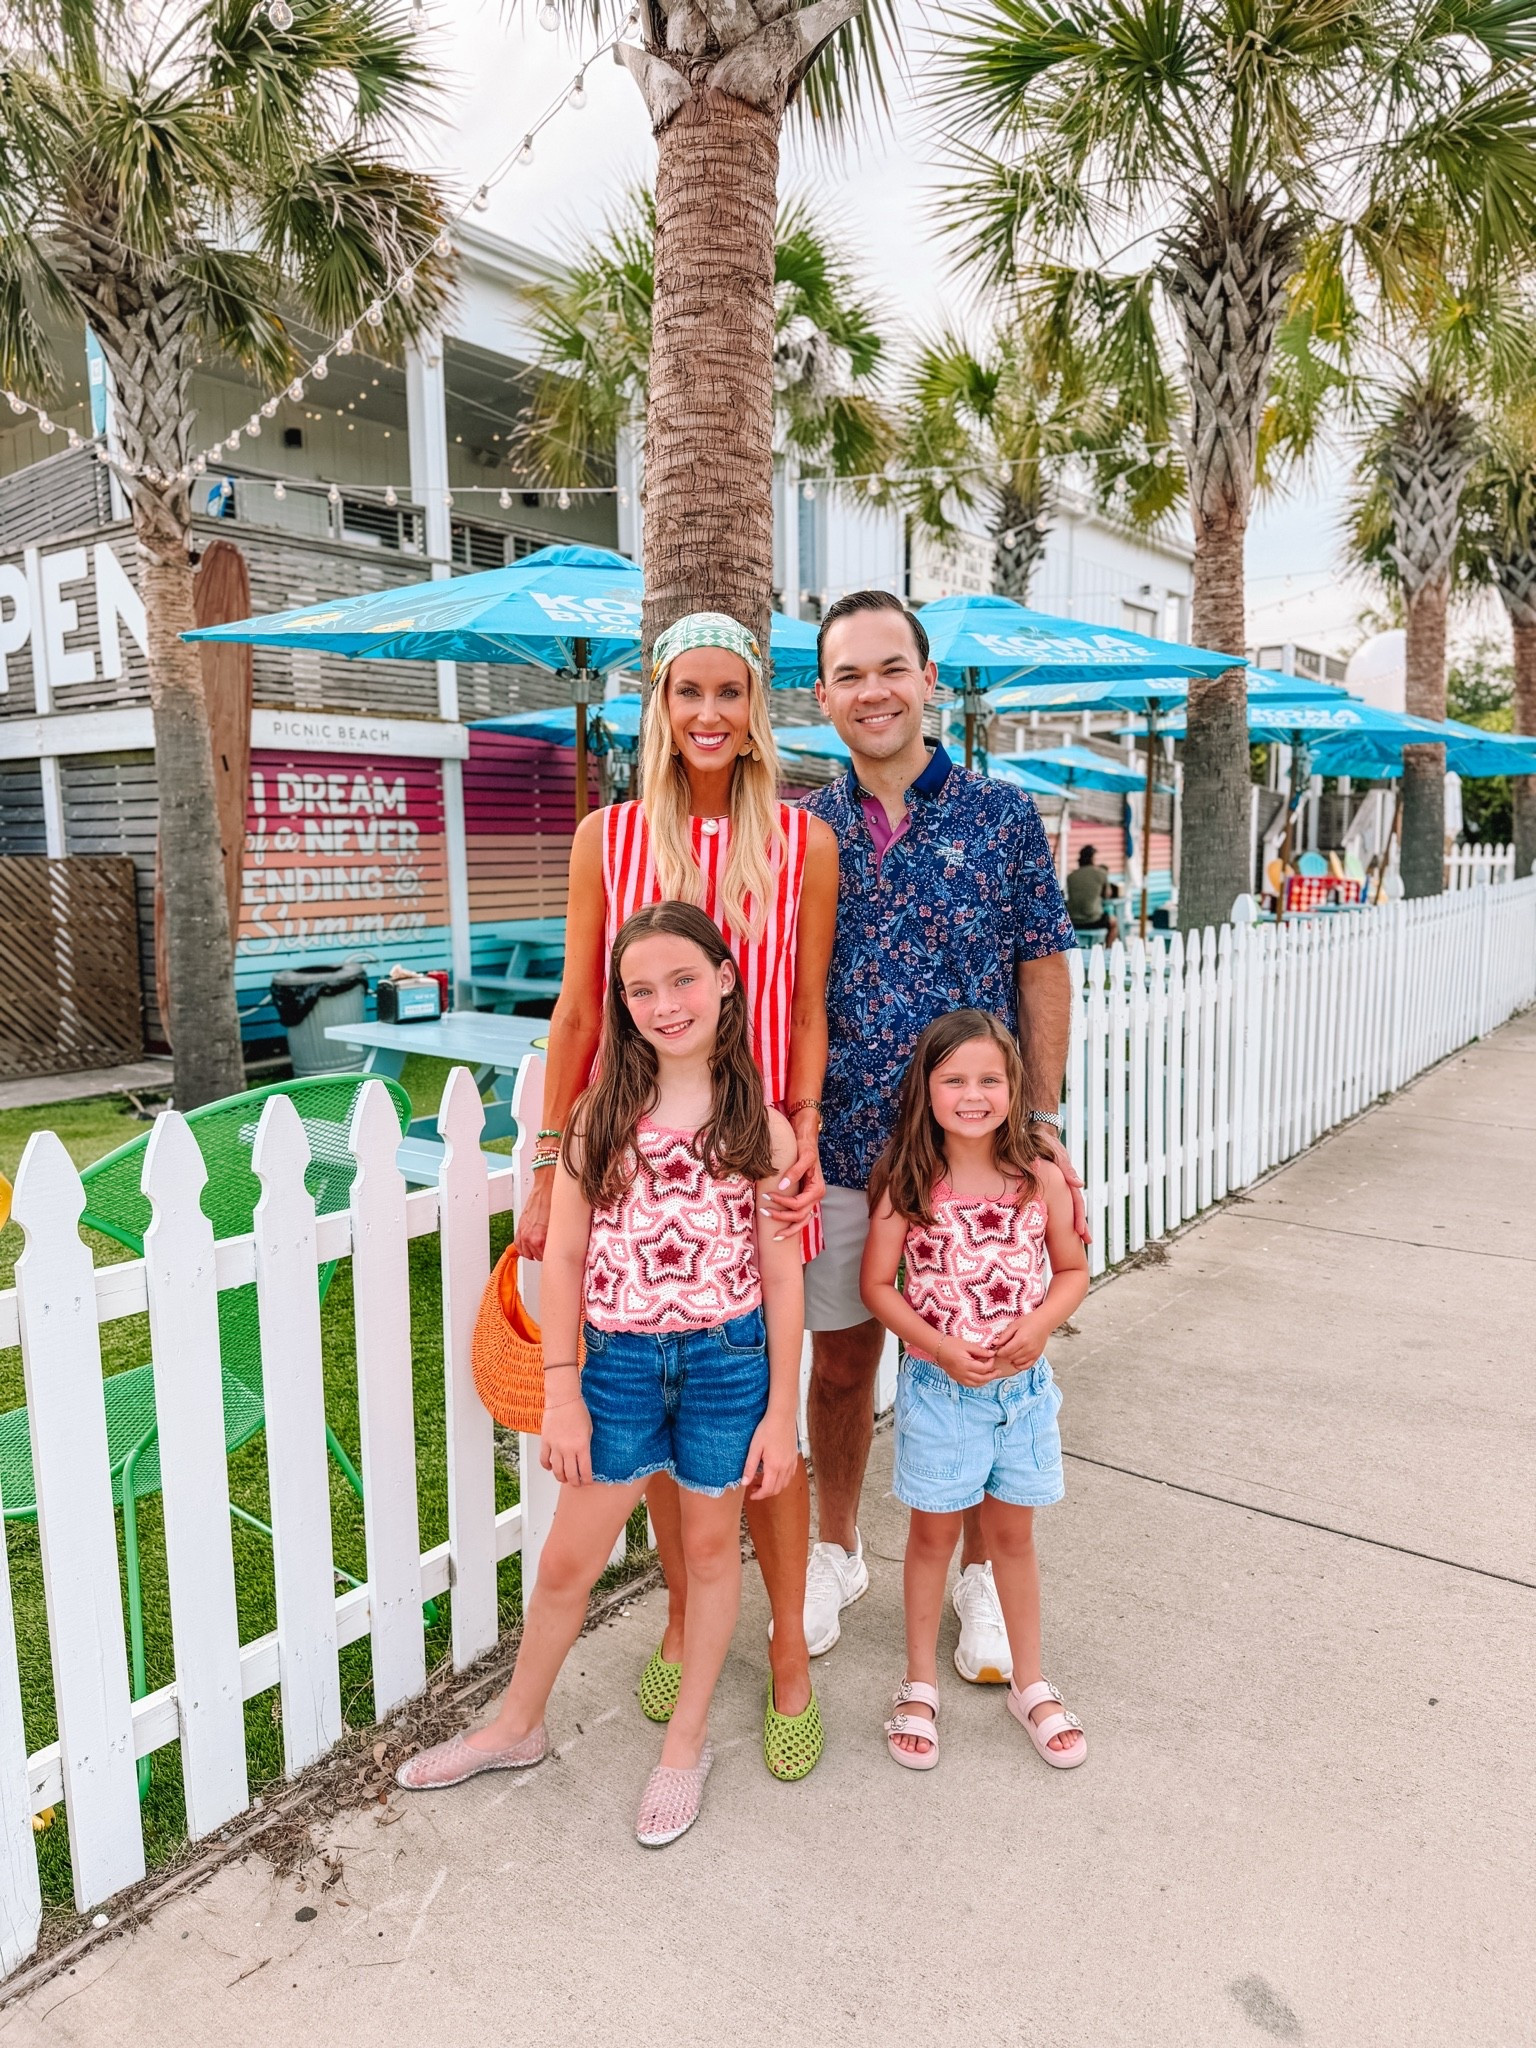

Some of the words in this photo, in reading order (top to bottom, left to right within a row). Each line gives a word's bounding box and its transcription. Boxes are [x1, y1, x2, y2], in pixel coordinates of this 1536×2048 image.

[528, 591, 642, 614] KO
[544, 608, 634, 625] BIG
[967, 632, 1138, 650] KONA
[987, 646, 1053, 658] BIG
[1050, 646, 1161, 659] WAVE
[273, 721, 332, 739] PICNIC
[338, 726, 391, 741] BEACH
[251, 771, 267, 814] I
[276, 772, 408, 816] DREAM
[273, 826, 301, 853] a
[304, 817, 422, 858] NEVER
[242, 866, 385, 904] ENDING
[238, 903, 427, 955] Summer
